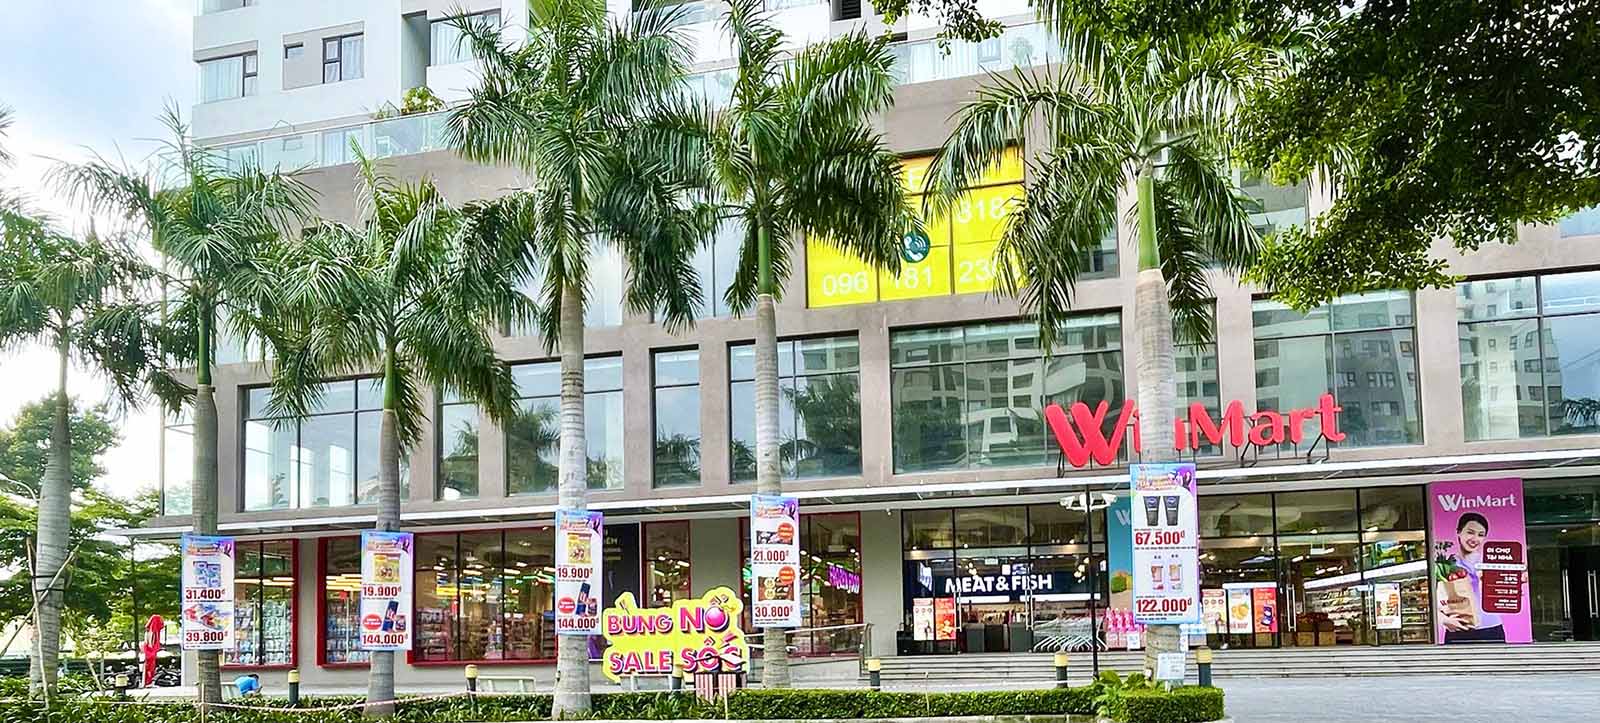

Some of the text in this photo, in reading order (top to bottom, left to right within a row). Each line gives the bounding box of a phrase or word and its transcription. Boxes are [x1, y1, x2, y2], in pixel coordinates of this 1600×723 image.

[822, 272, 868, 297] 096
[1437, 493, 1517, 512] WinMart
[945, 576, 993, 593] MEAT
[1012, 574, 1053, 590] FISH
[607, 600, 673, 635] BÙNG
[609, 650, 673, 674] SALE
